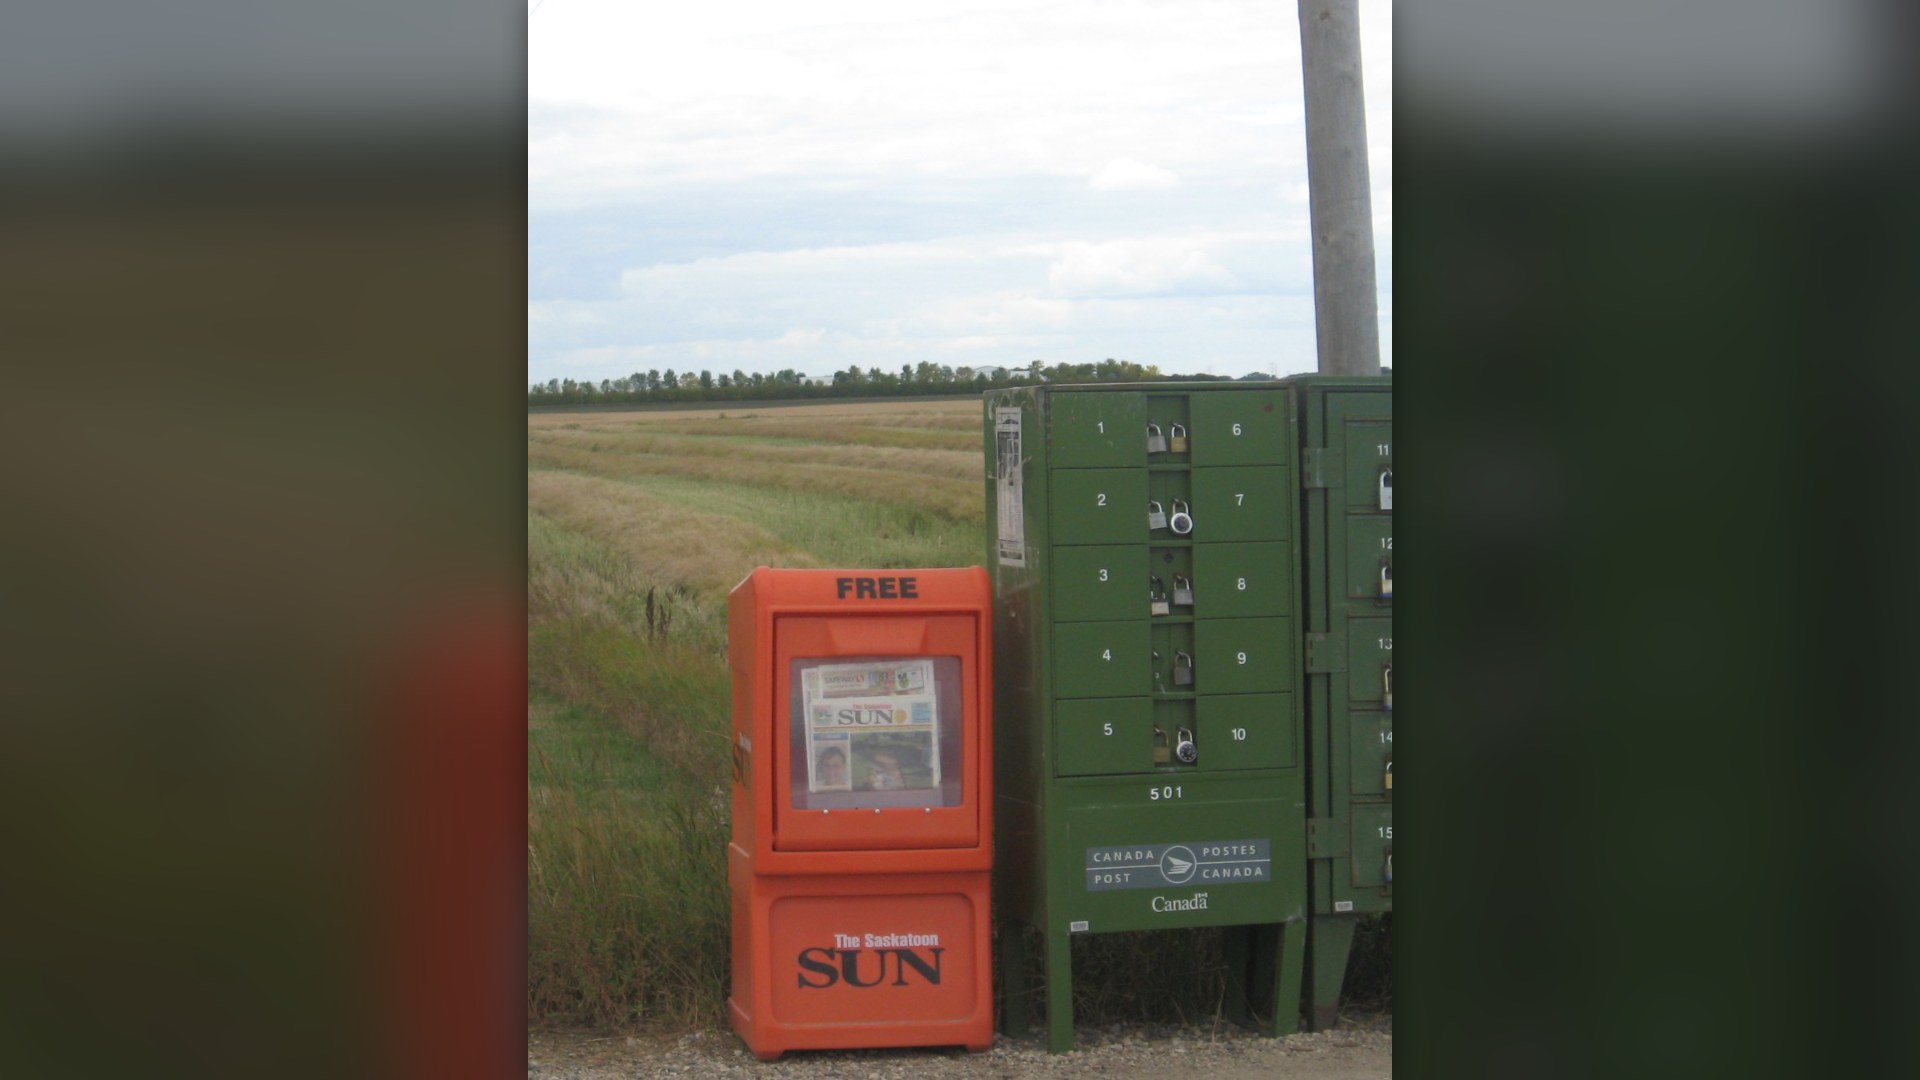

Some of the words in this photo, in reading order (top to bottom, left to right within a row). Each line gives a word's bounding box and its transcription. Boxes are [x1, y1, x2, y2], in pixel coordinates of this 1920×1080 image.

[1097, 421, 1105, 434] 1
[1232, 423, 1242, 436] 6
[1376, 443, 1390, 456] 11
[1097, 493, 1107, 506] 2
[1235, 493, 1245, 506] 7
[1099, 568, 1109, 582] 3
[836, 577, 919, 599] FREE
[1237, 577, 1246, 591] 8
[1102, 649, 1112, 662] 4
[1237, 652, 1247, 665] 9
[838, 709, 894, 726] SUN
[1103, 723, 1113, 736] 5
[1231, 727, 1247, 741] 10
[1093, 850, 1154, 863] CANADA
[1203, 845, 1257, 857] POSTES
[1095, 873, 1131, 884] POST
[1203, 866, 1264, 879] CANADA
[1152, 893, 1208, 912] Canada
[835, 934, 861, 949] The
[864, 933, 939, 948] Saskatoon
[797, 947, 945, 989] SUN
